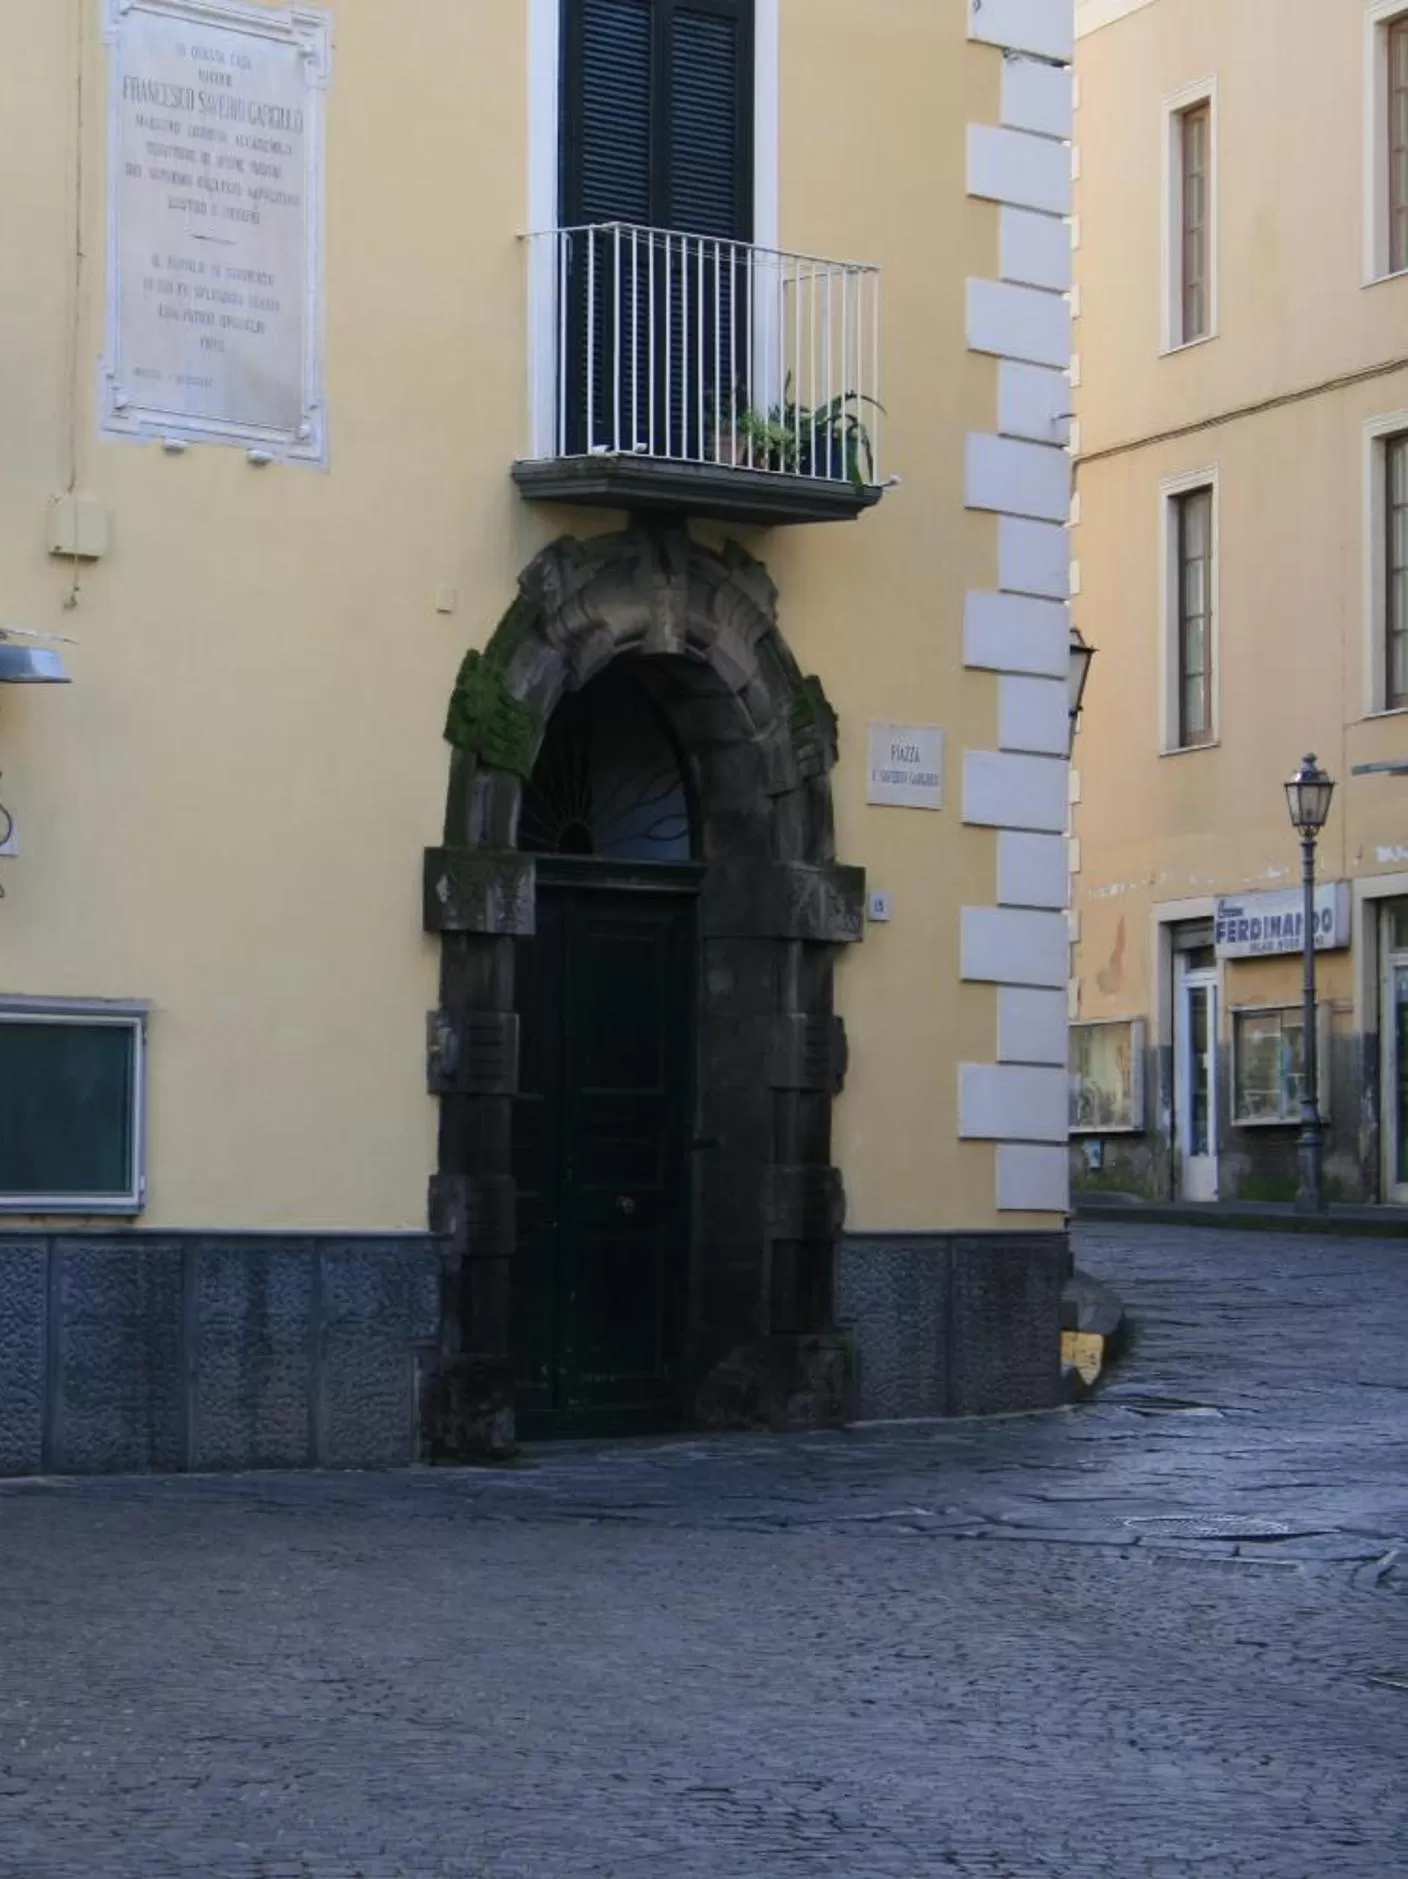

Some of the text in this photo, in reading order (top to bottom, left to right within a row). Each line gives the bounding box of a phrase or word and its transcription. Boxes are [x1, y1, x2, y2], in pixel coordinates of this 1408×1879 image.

[123, 75, 195, 112] FRANCESCO
[198, 90, 247, 121] SAVERIO
[891, 743, 920, 763] PIAZZA
